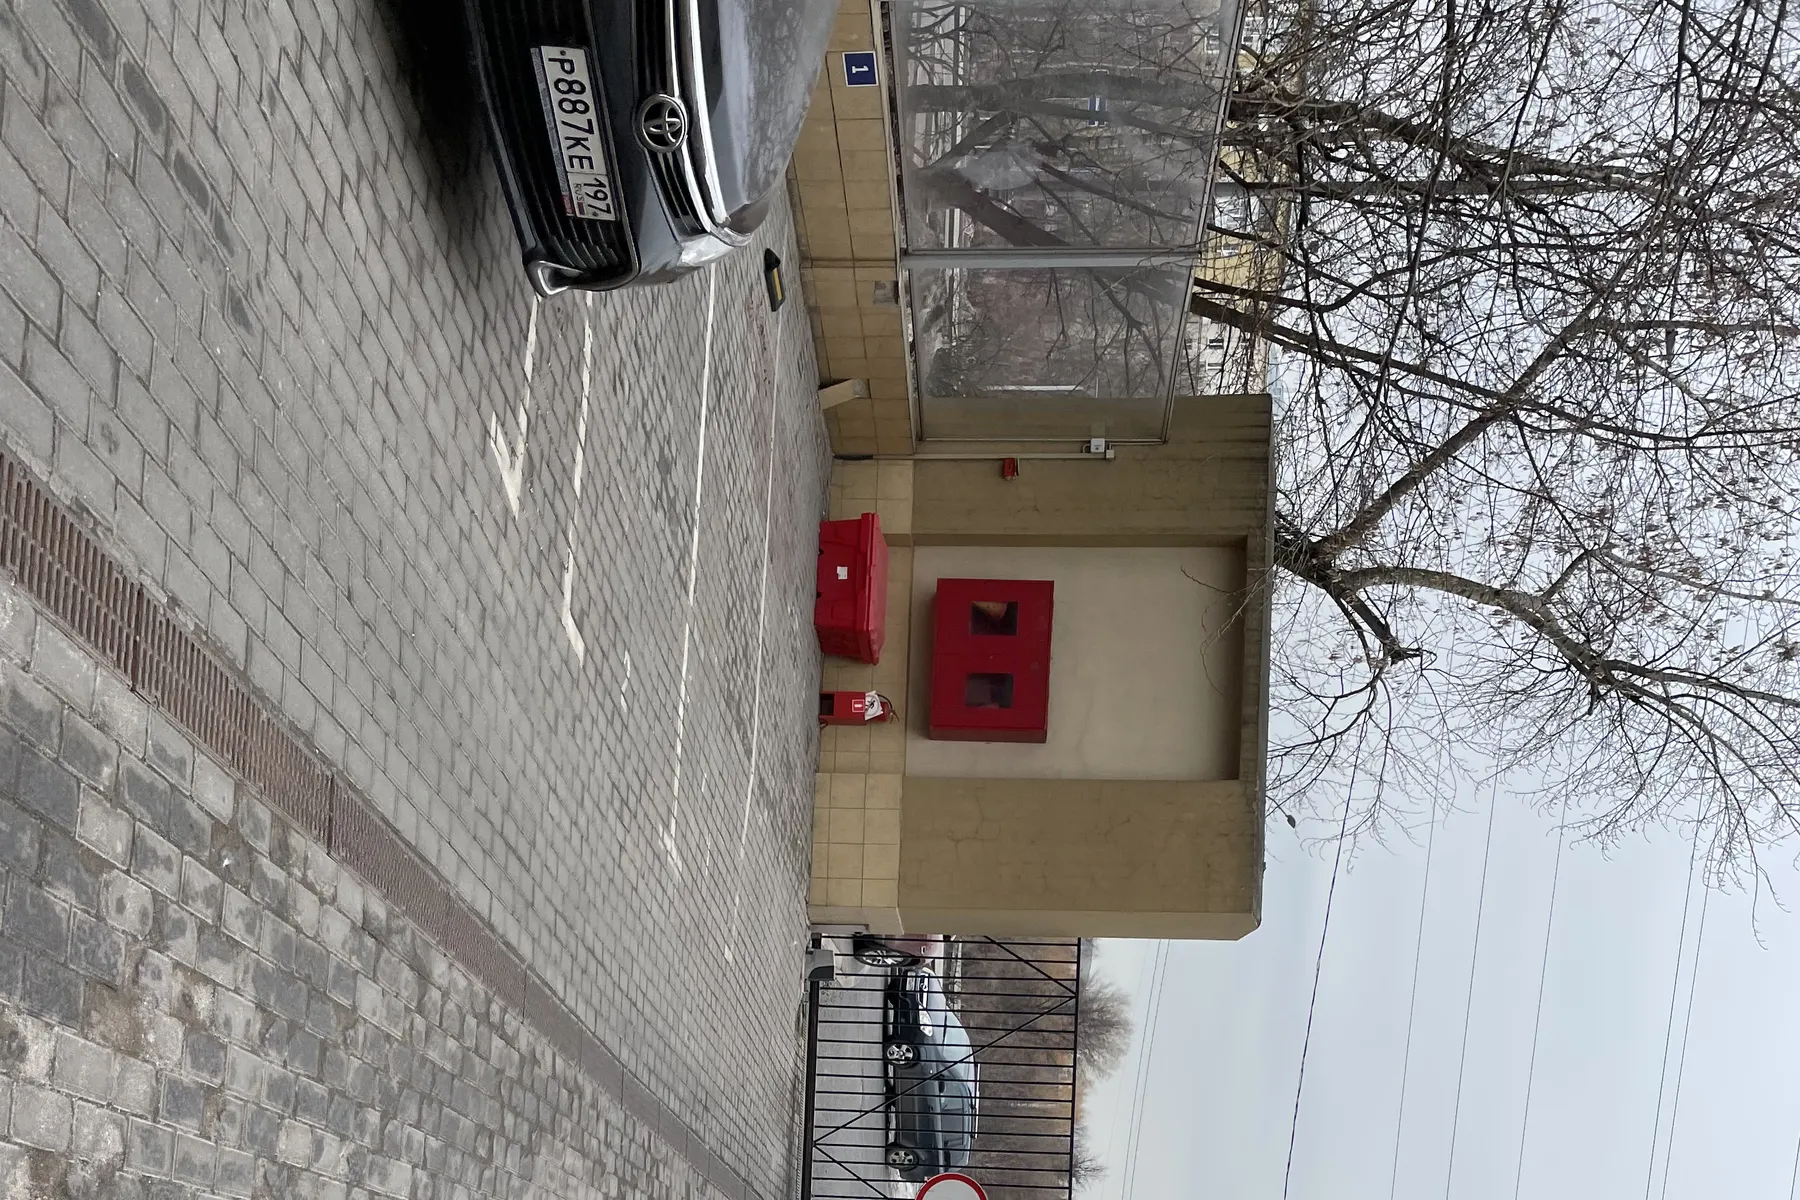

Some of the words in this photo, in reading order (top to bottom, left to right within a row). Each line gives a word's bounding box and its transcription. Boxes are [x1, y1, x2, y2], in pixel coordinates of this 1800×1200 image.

[548, 57, 594, 170] Р887КЕ
[584, 177, 611, 214] 197
[573, 182, 584, 202] RUS
